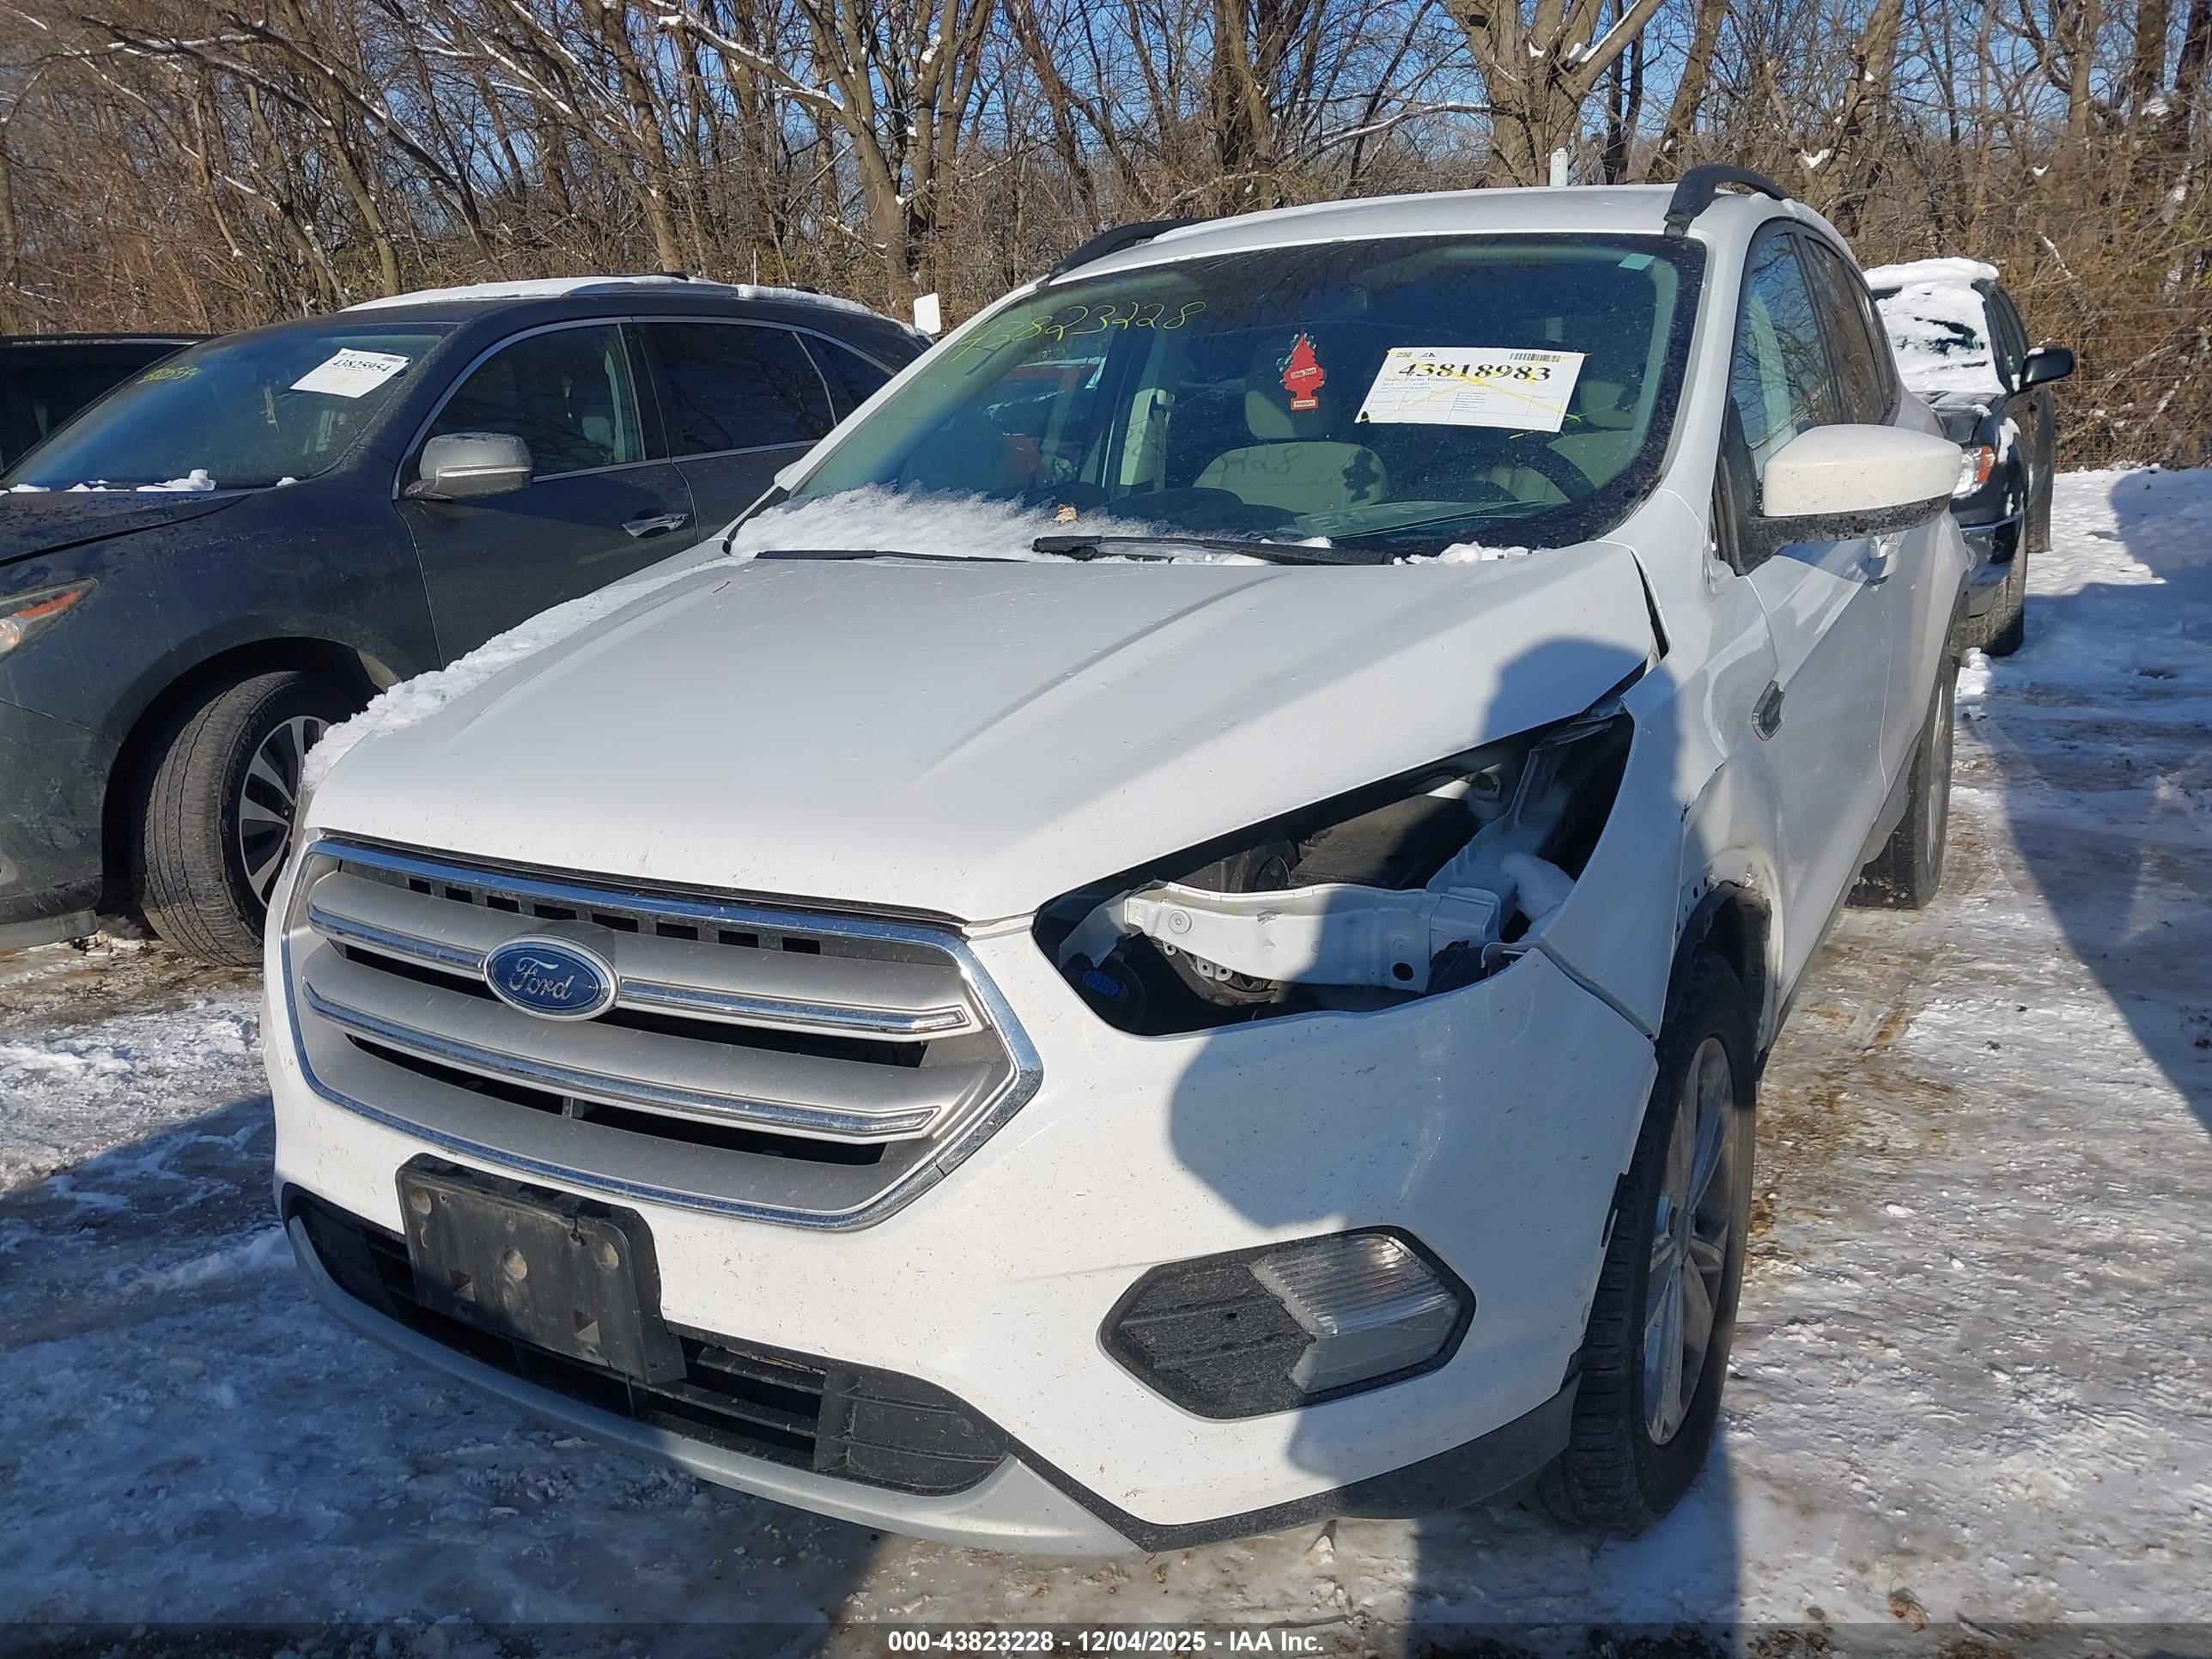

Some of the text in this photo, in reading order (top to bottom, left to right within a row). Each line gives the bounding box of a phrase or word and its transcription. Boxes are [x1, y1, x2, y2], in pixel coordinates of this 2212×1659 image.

[331, 358, 392, 373] 43825954
[1398, 362, 1552, 381] 43818983
[508, 957, 575, 1000] Ford
